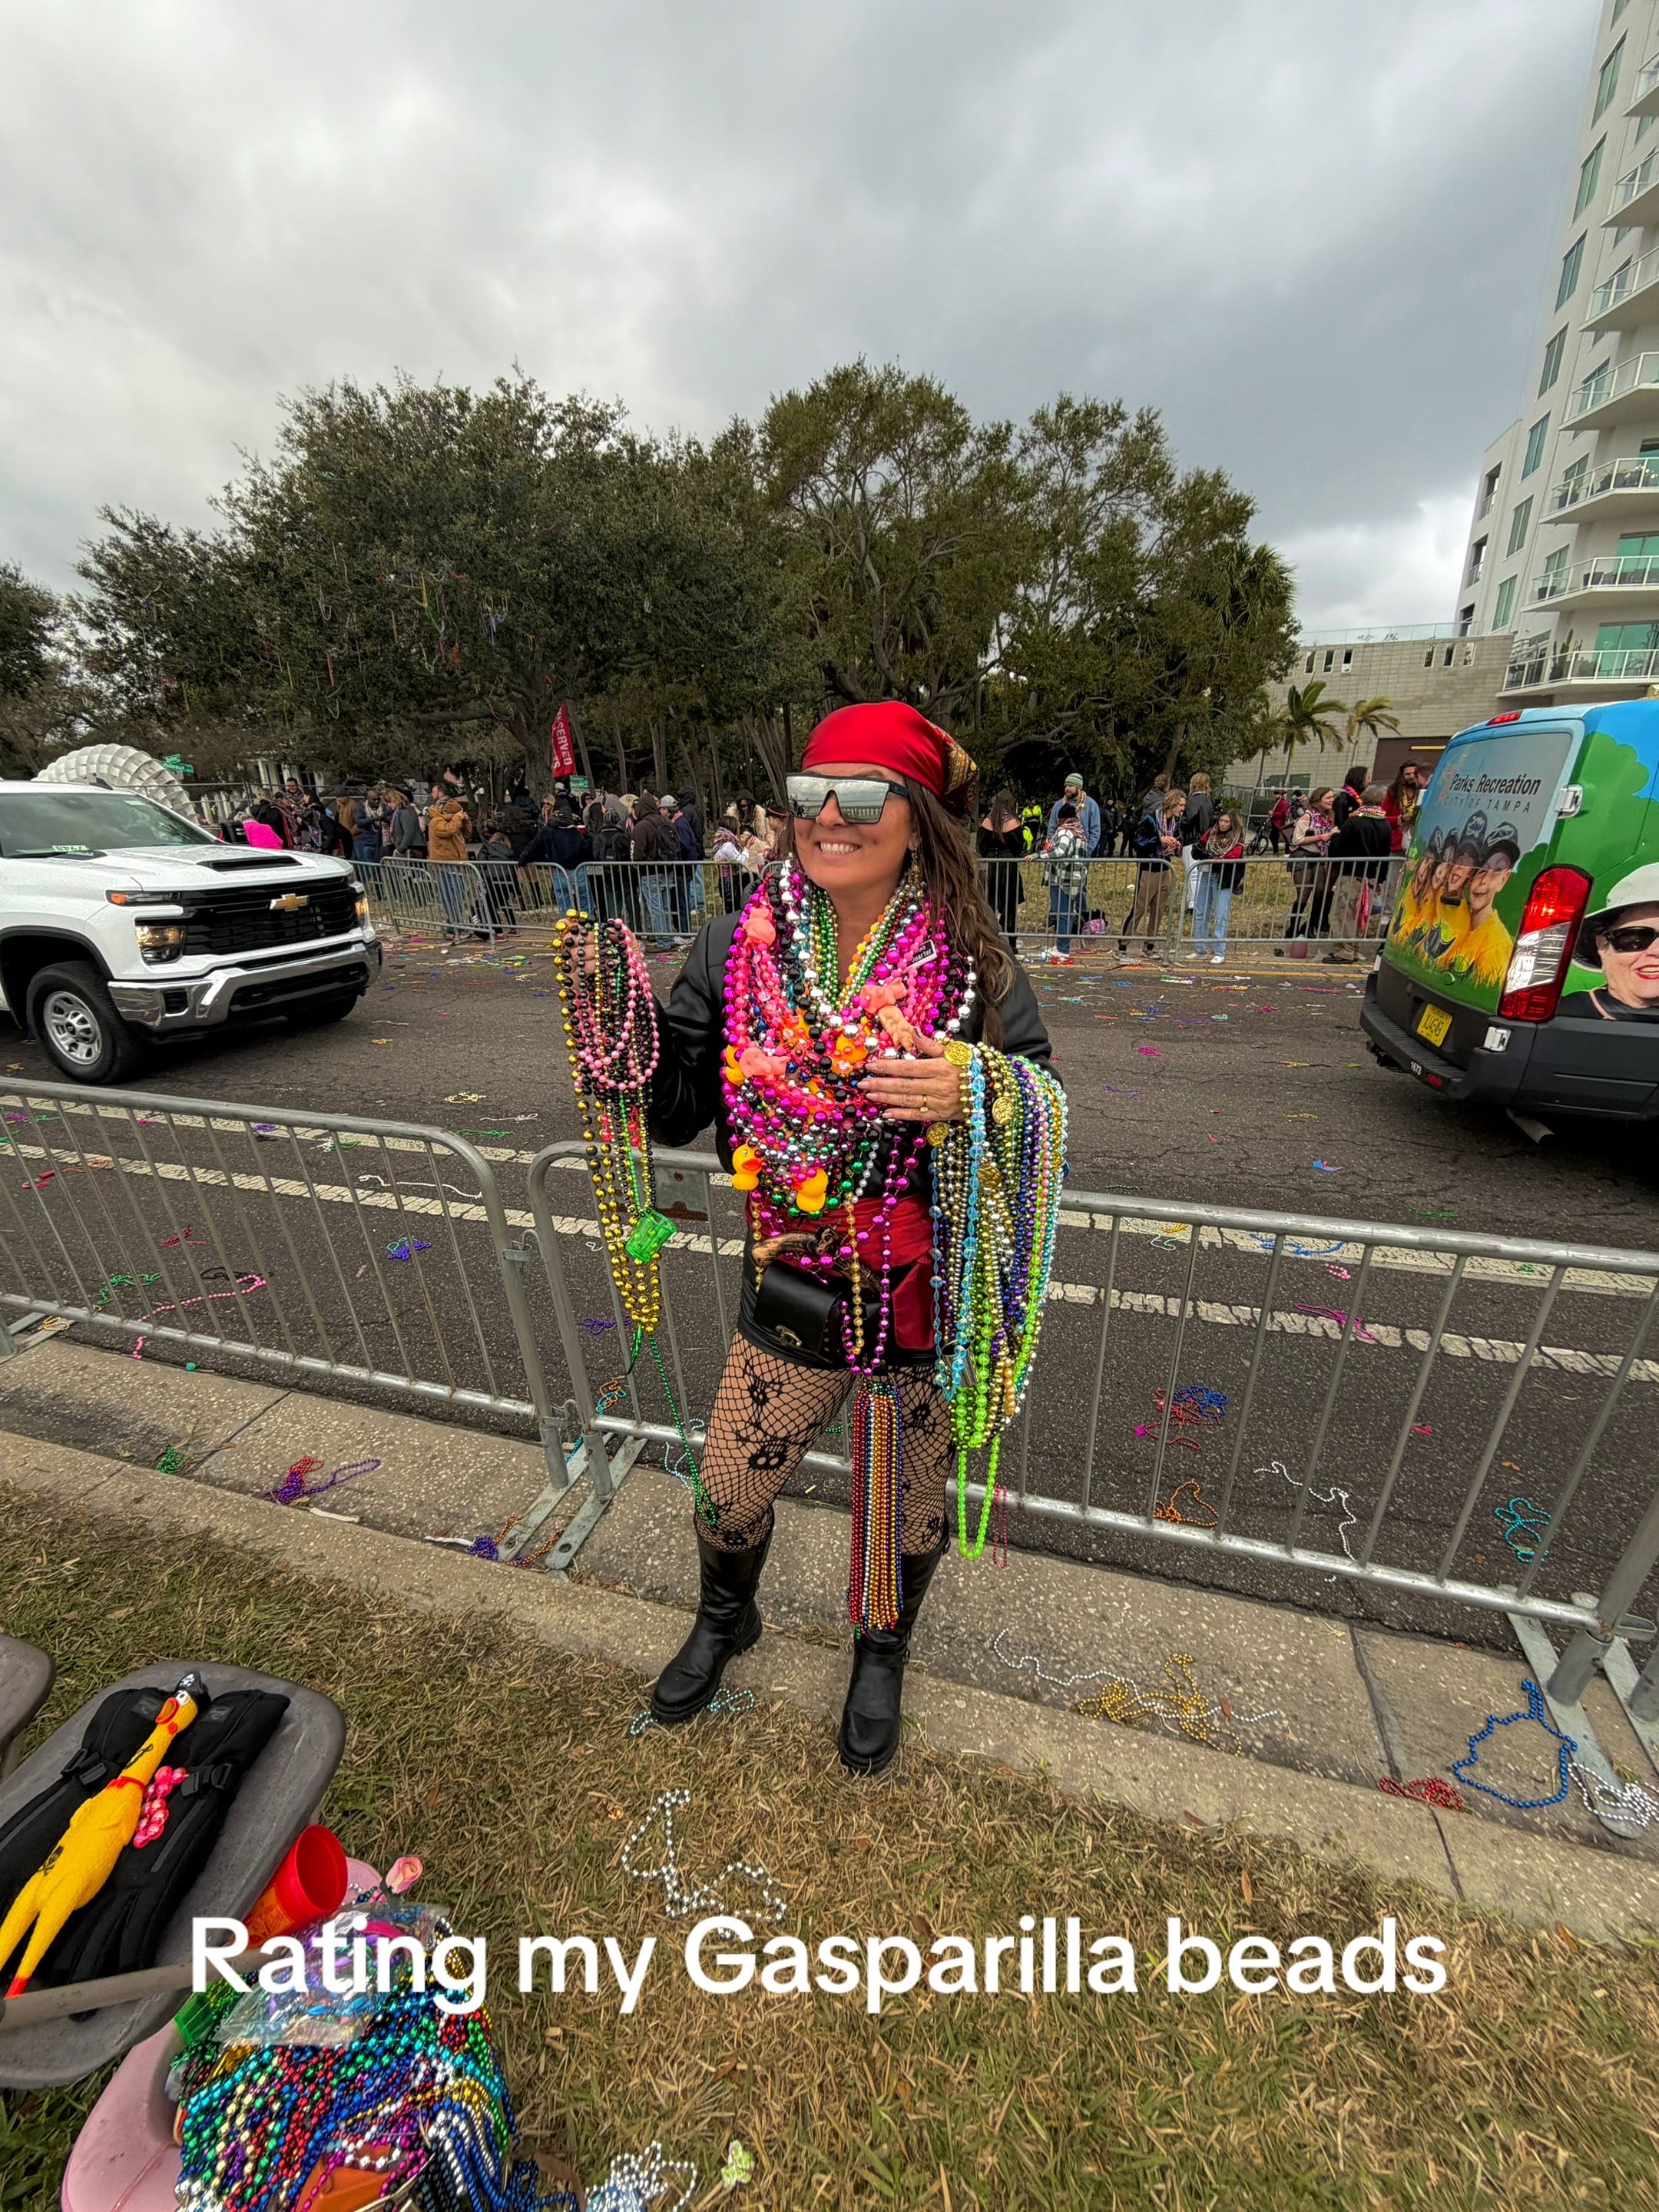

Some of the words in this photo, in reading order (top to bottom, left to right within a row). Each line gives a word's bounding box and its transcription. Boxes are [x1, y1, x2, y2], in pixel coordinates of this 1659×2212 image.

[1449, 773, 1475, 793] Parks
[1475, 773, 1541, 796] Recreation
[1444, 796, 1464, 807] CITY
[1468, 798, 1481, 809] OF
[1487, 799, 1531, 813] TAMPA
